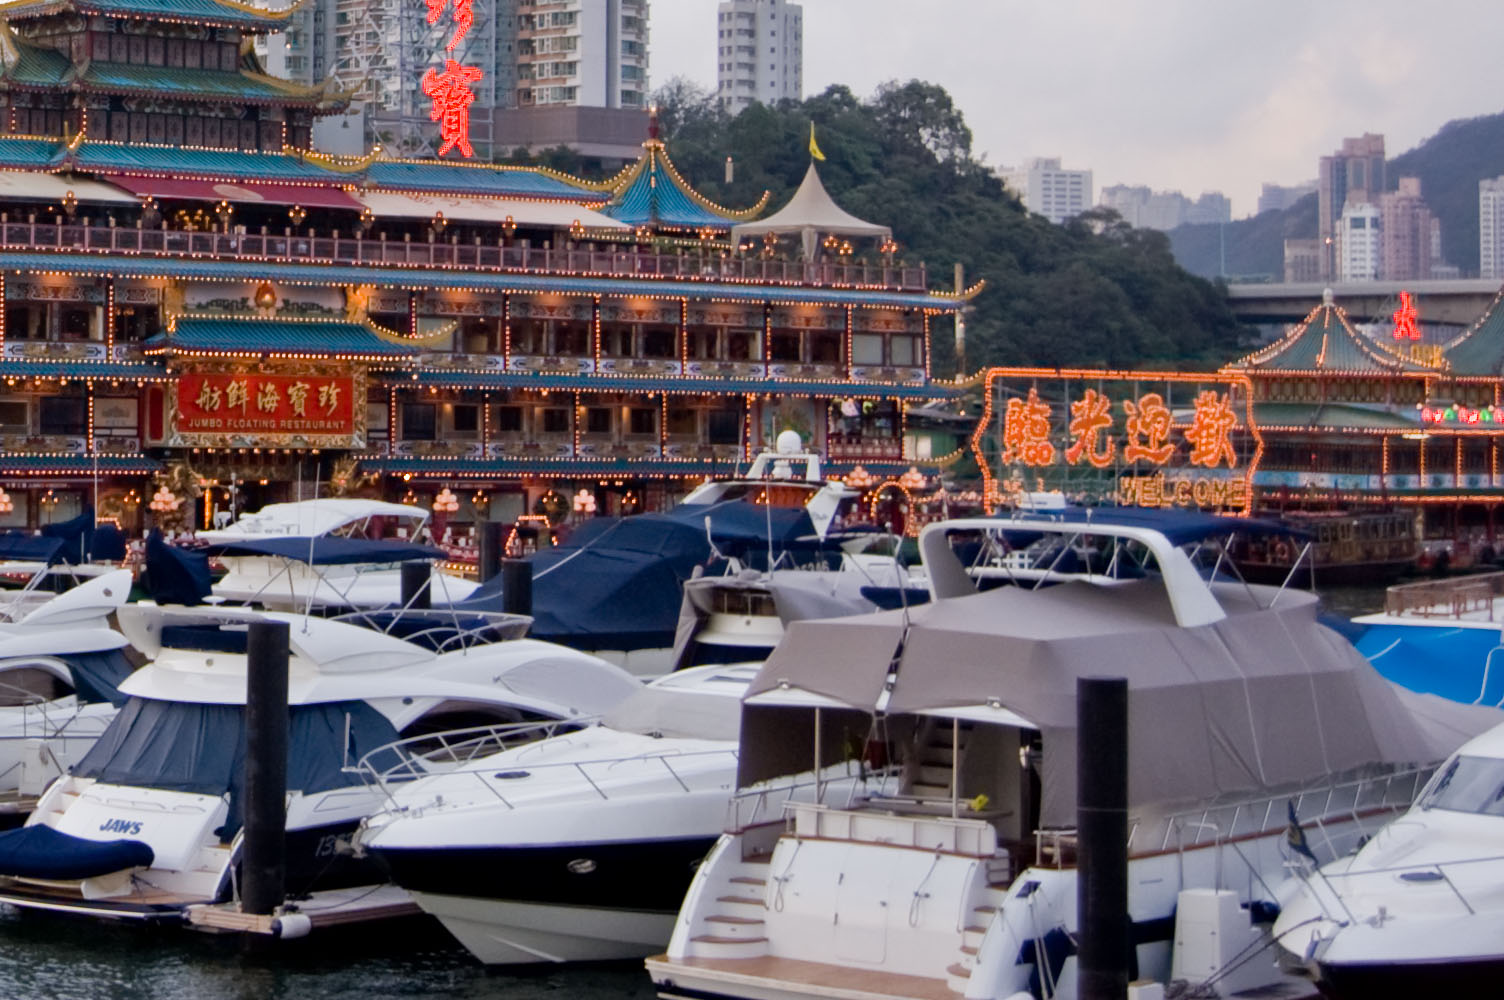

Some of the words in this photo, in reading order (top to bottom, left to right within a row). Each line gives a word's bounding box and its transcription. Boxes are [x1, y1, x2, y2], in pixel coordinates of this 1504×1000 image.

[188, 418, 223, 428] JUMBO
[227, 419, 276, 429] FLOATING
[280, 420, 345, 430] RESTAURANT
[1119, 475, 1248, 507] WELCOME
[99, 818, 144, 835] JAWS
